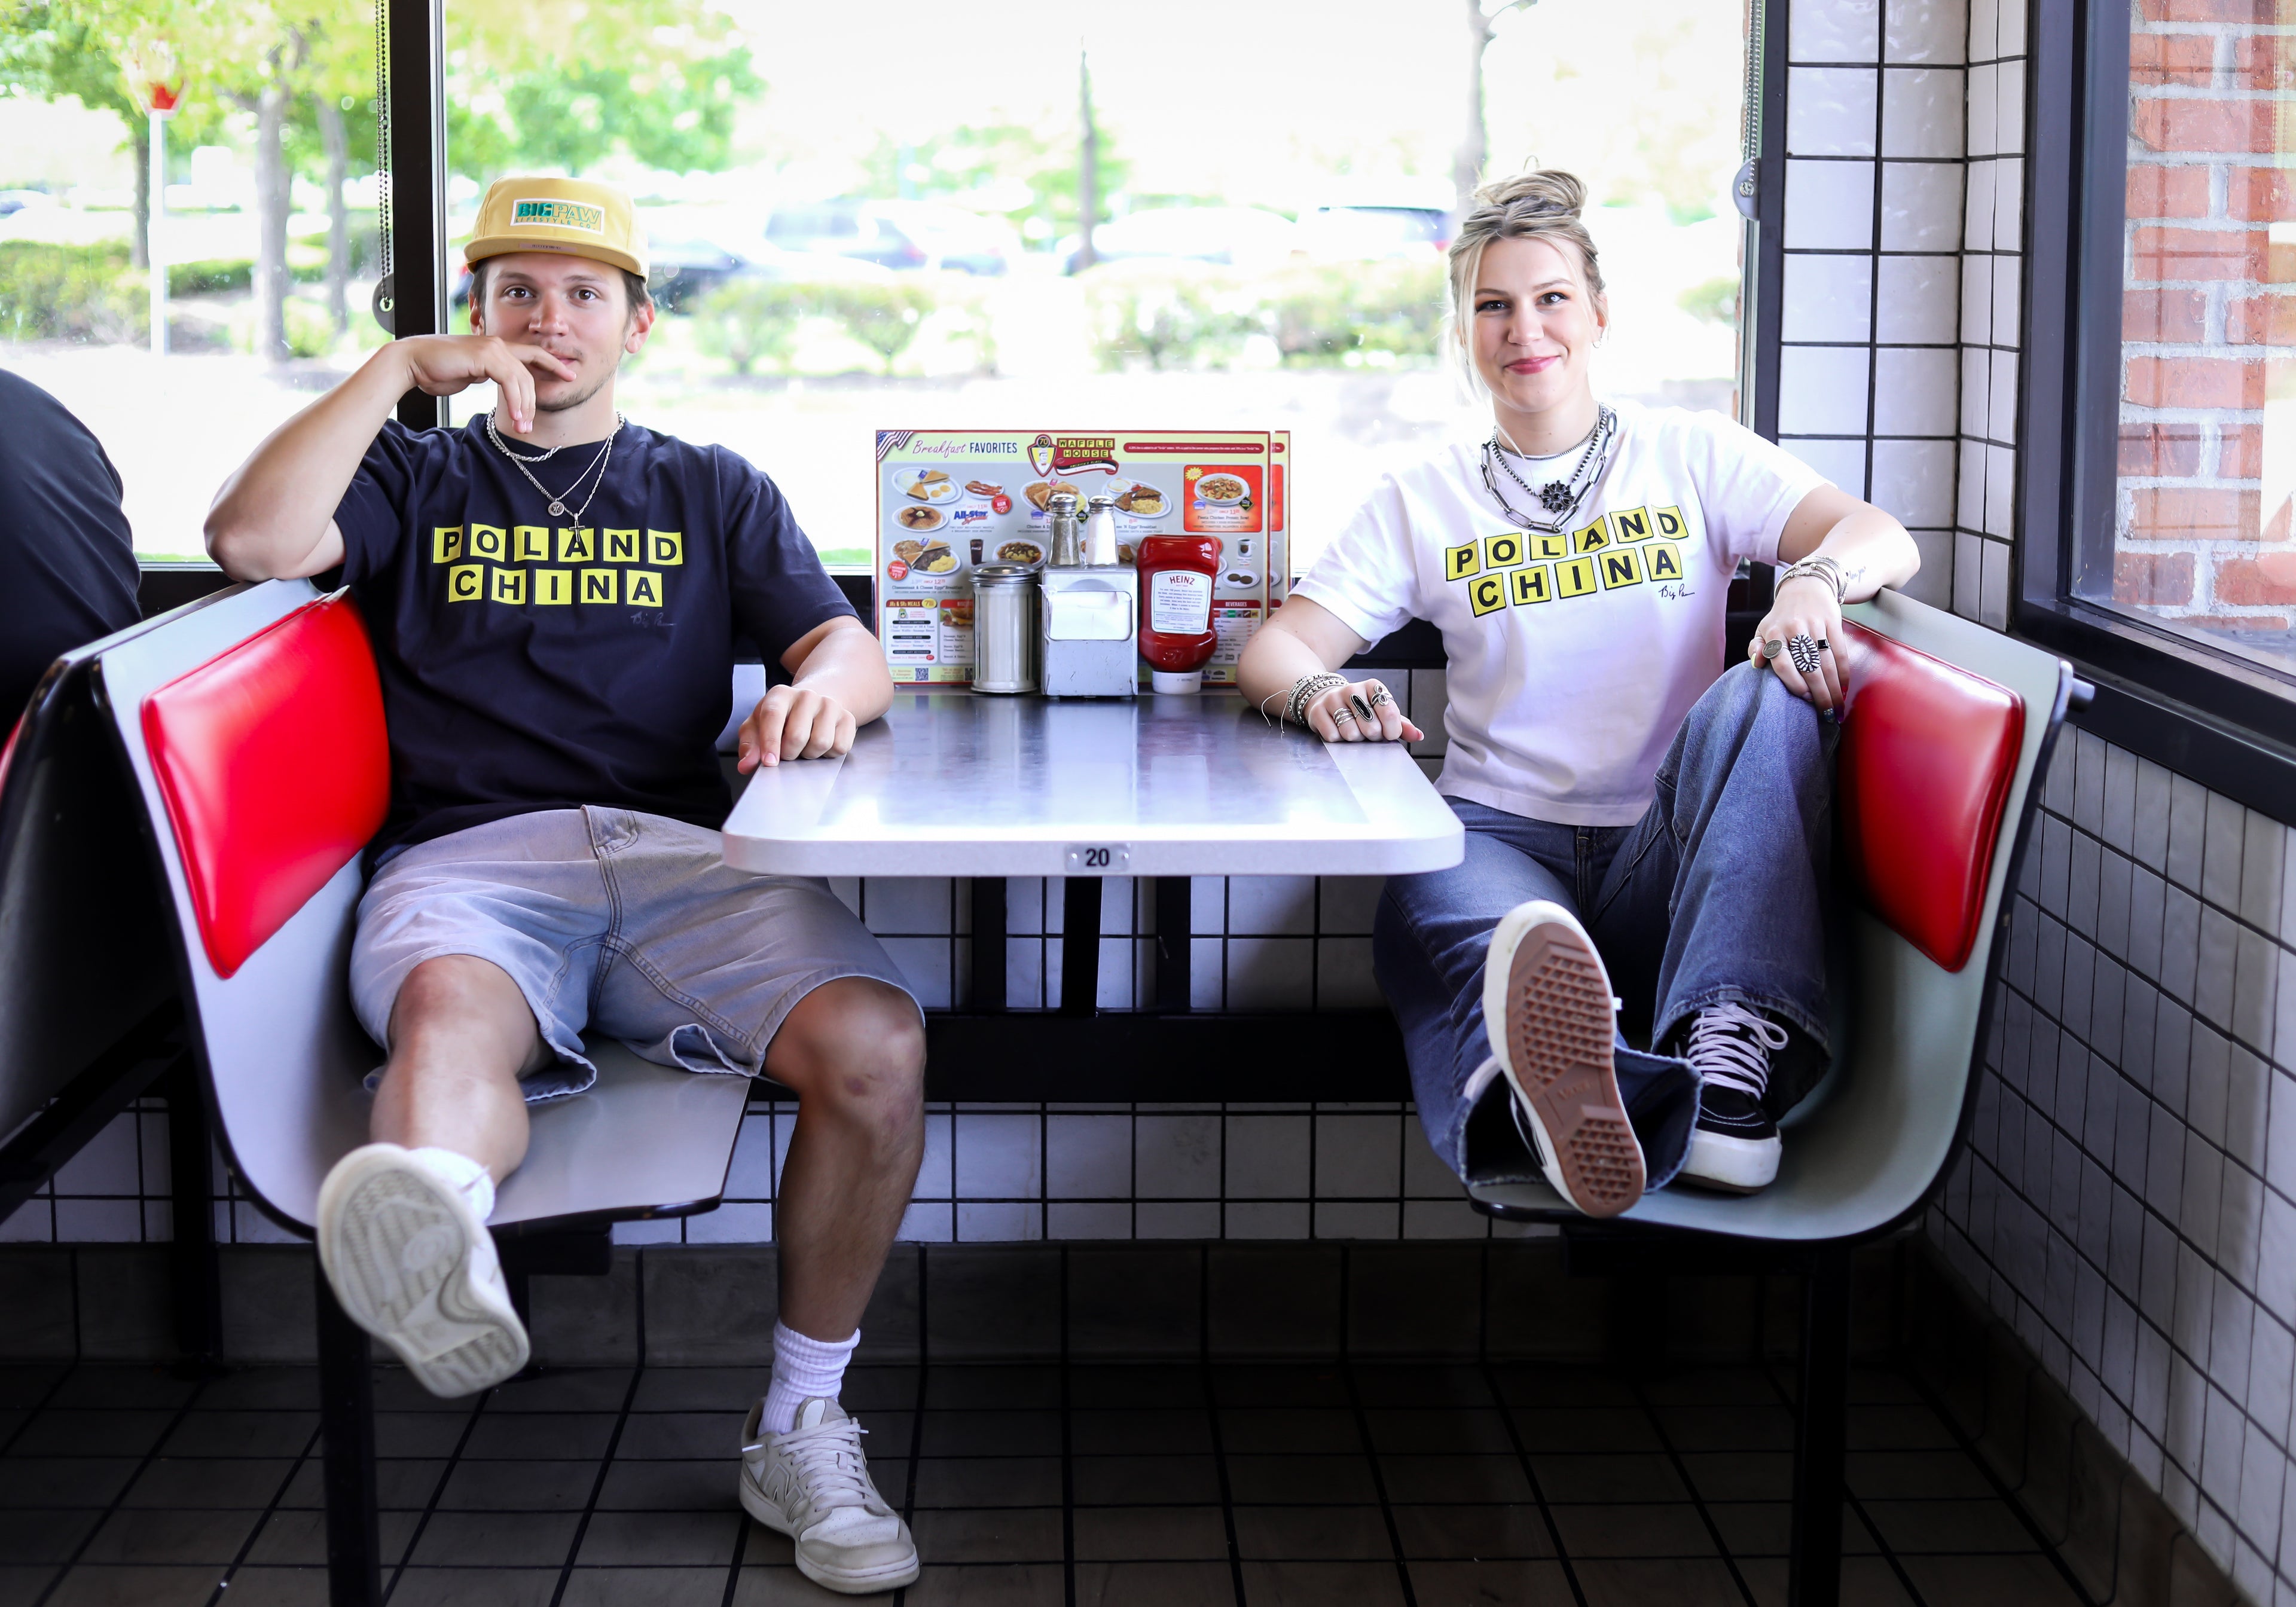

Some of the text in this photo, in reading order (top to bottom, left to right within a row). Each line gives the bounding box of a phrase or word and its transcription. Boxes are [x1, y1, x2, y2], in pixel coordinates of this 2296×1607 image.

[515, 217, 596, 230] LIFESTYLE CO.
[912, 440, 1018, 459] Breakfast FAVORITES
[954, 510, 988, 520] All-Star
[442, 529, 678, 561] POLAND
[1456, 512, 1680, 574] POLAND
[454, 570, 657, 603] CHINA
[1170, 575, 1195, 585] HEINZ
[1477, 549, 1677, 608] CHINA
[1085, 848, 1110, 867] 20
